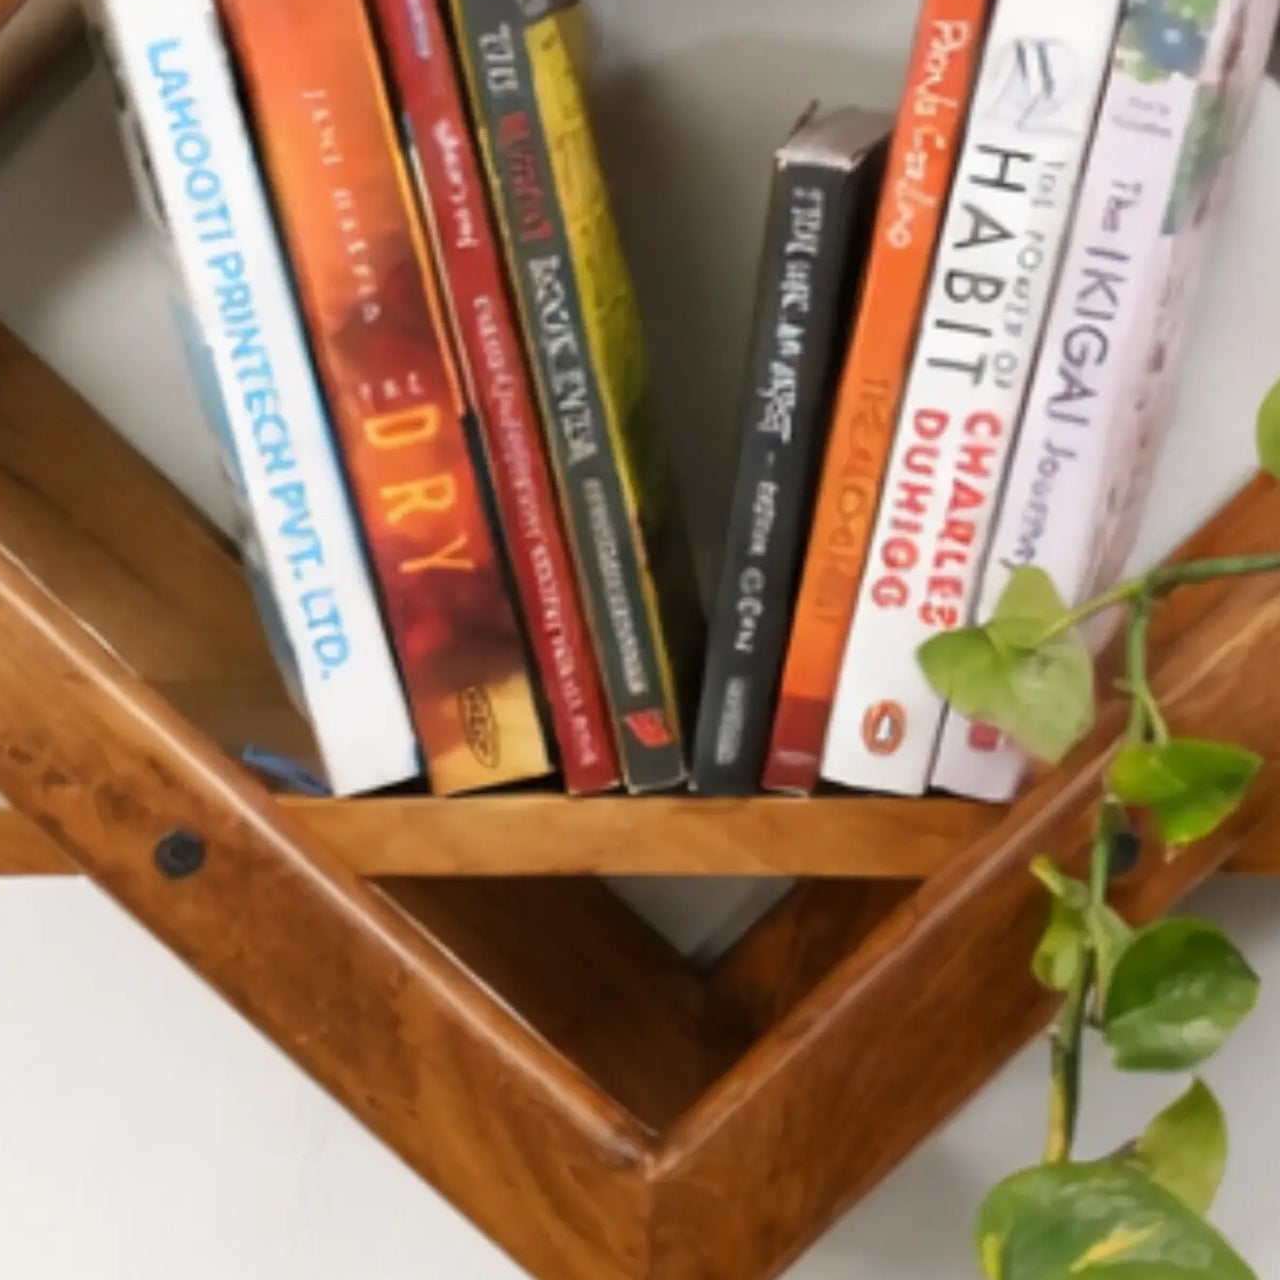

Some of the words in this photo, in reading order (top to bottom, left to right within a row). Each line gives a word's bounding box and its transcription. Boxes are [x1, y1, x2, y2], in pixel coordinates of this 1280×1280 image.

[147, 37, 233, 243] LAHOOTI
[207, 251, 297, 475] PRINTECH
[270, 480, 324, 581] PVT.
[298, 587, 351, 680] LTD.
[926, 142, 1036, 388] HABIT
[1045, 245, 1131, 428] IKIGAI
[363, 403, 478, 575] DRY
[871, 408, 951, 610] DUHIGG
[919, 411, 1005, 628] CHARLES
